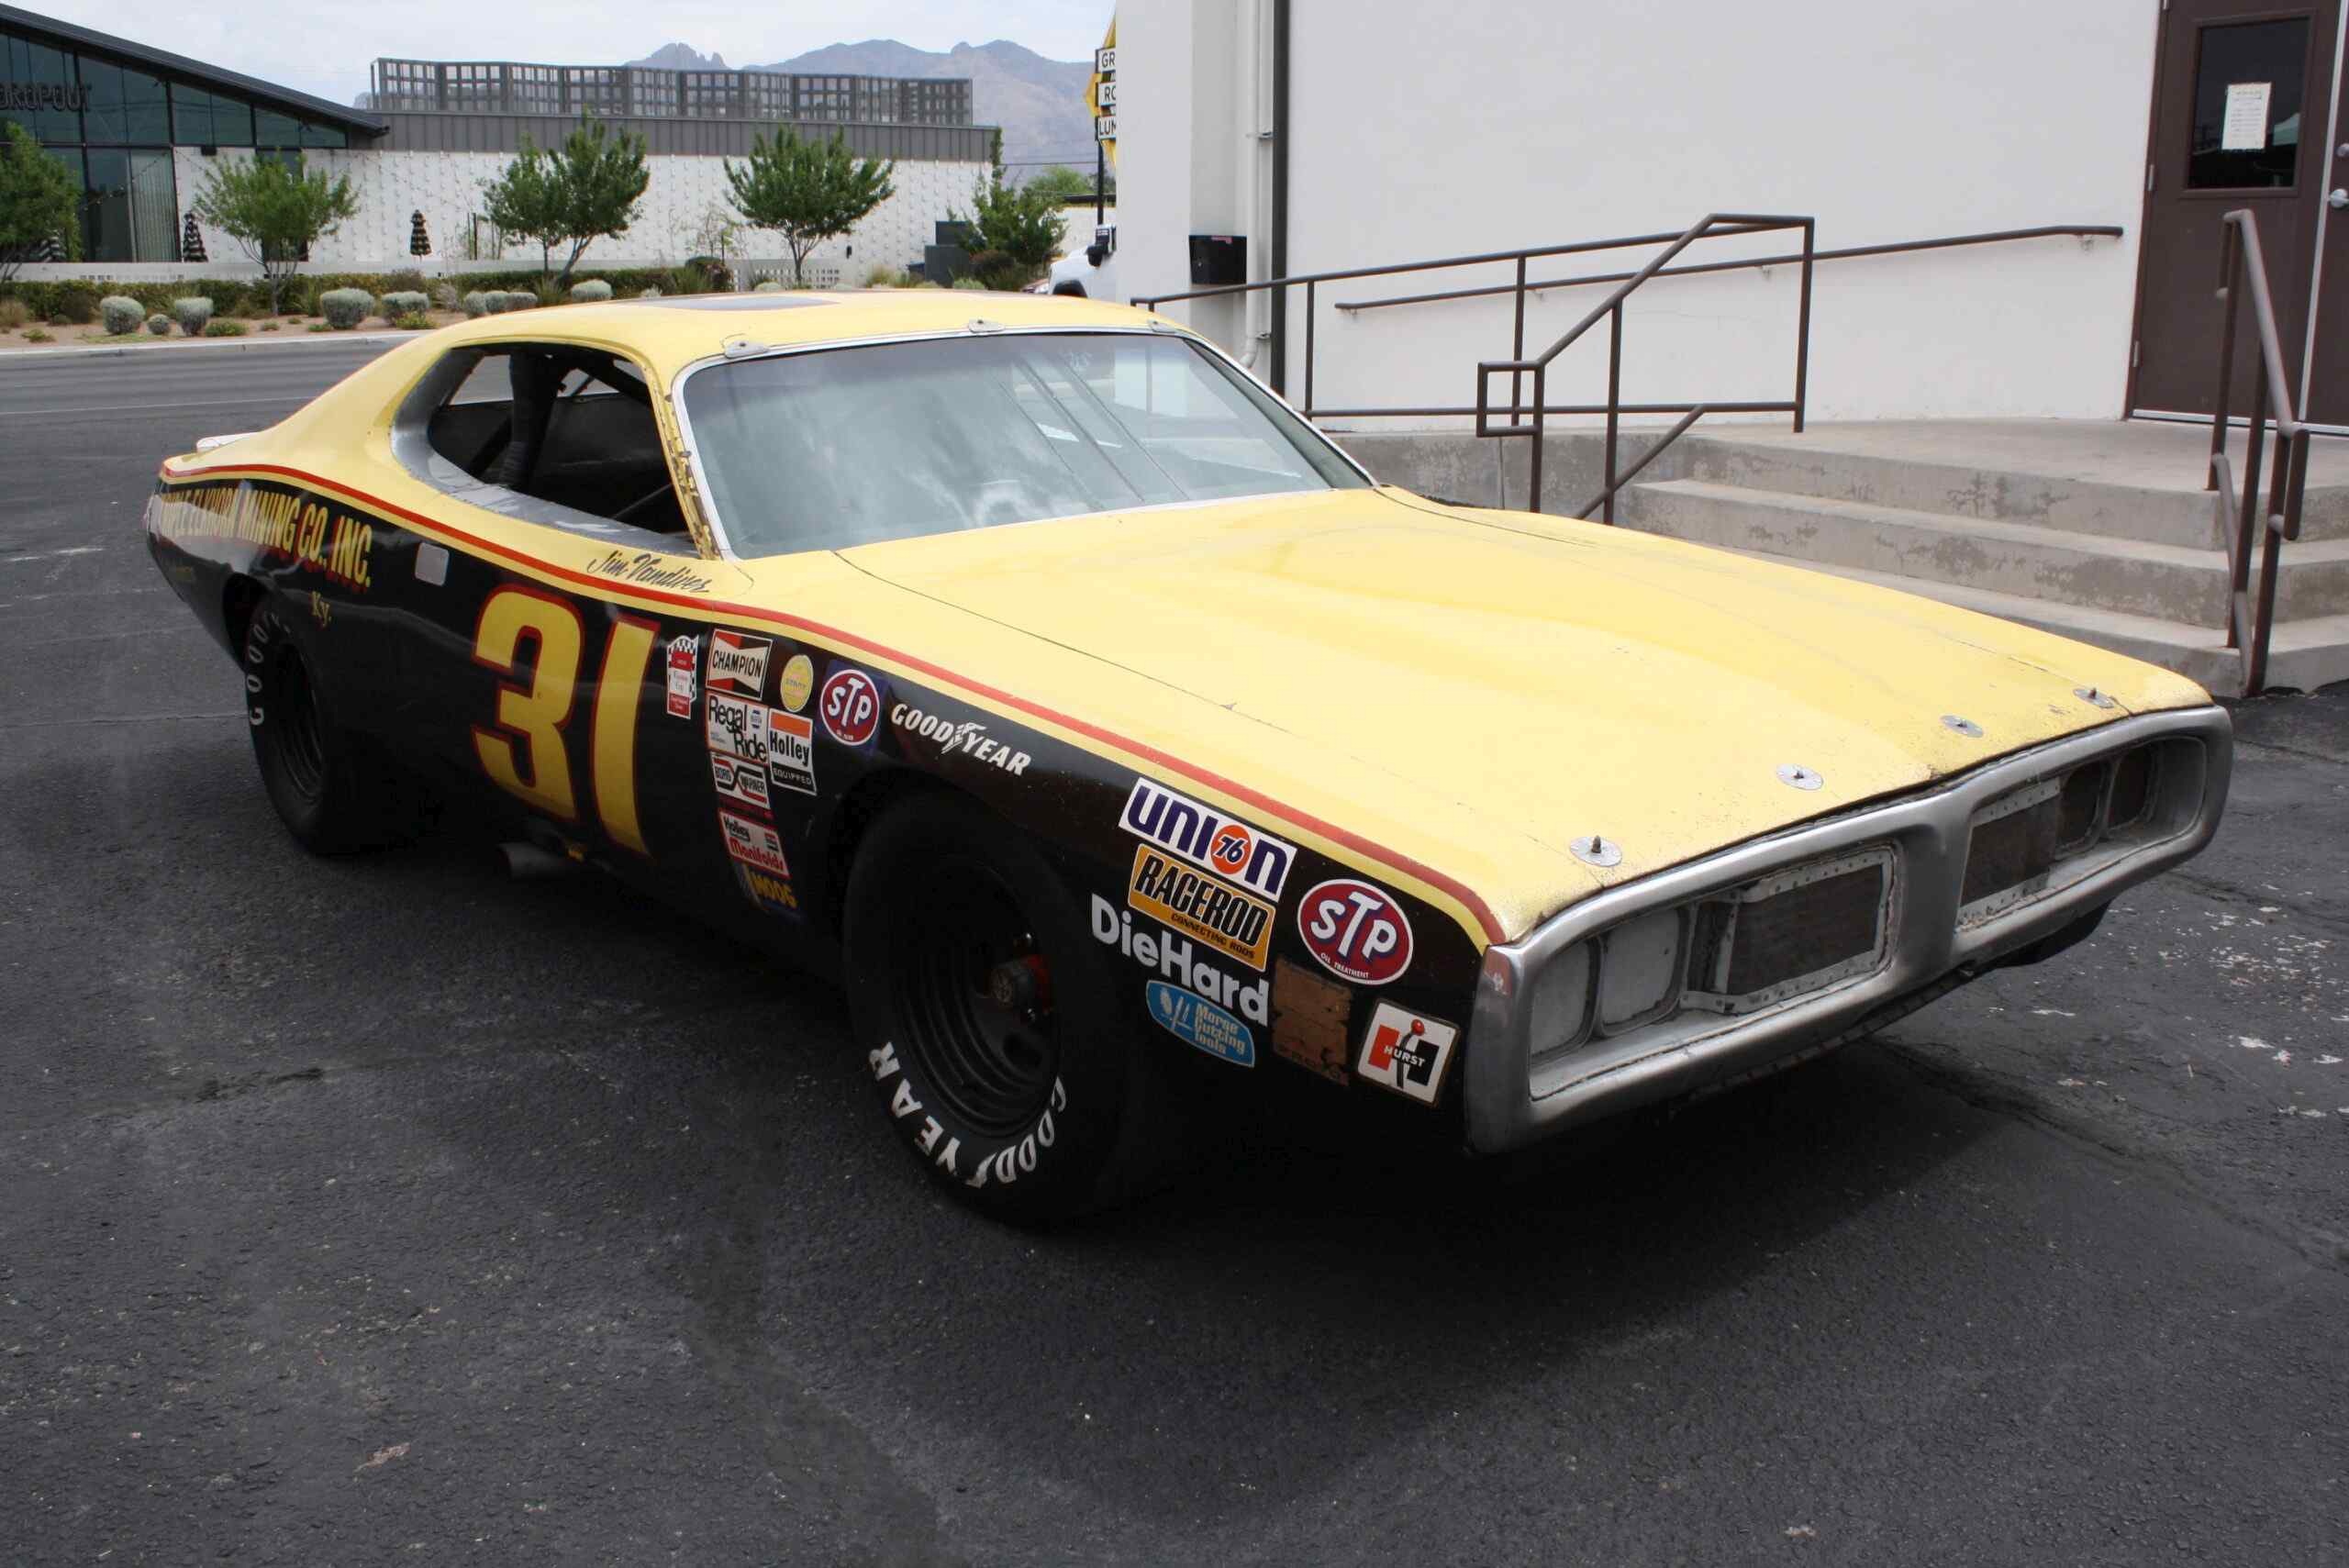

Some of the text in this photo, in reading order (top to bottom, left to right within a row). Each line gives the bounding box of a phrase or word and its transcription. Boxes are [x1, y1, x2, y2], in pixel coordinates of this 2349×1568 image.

[238, 488, 301, 553] MINING
[330, 515, 373, 587] INC.
[712, 650, 763, 679] CHAMPION
[471, 584, 661, 857] 31
[708, 695, 748, 734] Regal
[827, 677, 873, 728] STP
[734, 730, 767, 762] Ride
[770, 729, 810, 768] Holley
[890, 703, 1032, 776] GOODYEAR
[774, 767, 813, 785] EQUIPPED
[1214, 835, 1249, 865] 76
[1134, 853, 1268, 948] RACEROD
[1171, 912, 1256, 960] CONNECTING RODS
[1310, 891, 1397, 960] STP
[1091, 892, 1270, 1028] DieHard
[1320, 952, 1370, 980] OIL TREATMENT
[1384, 1044, 1427, 1067] HURST
